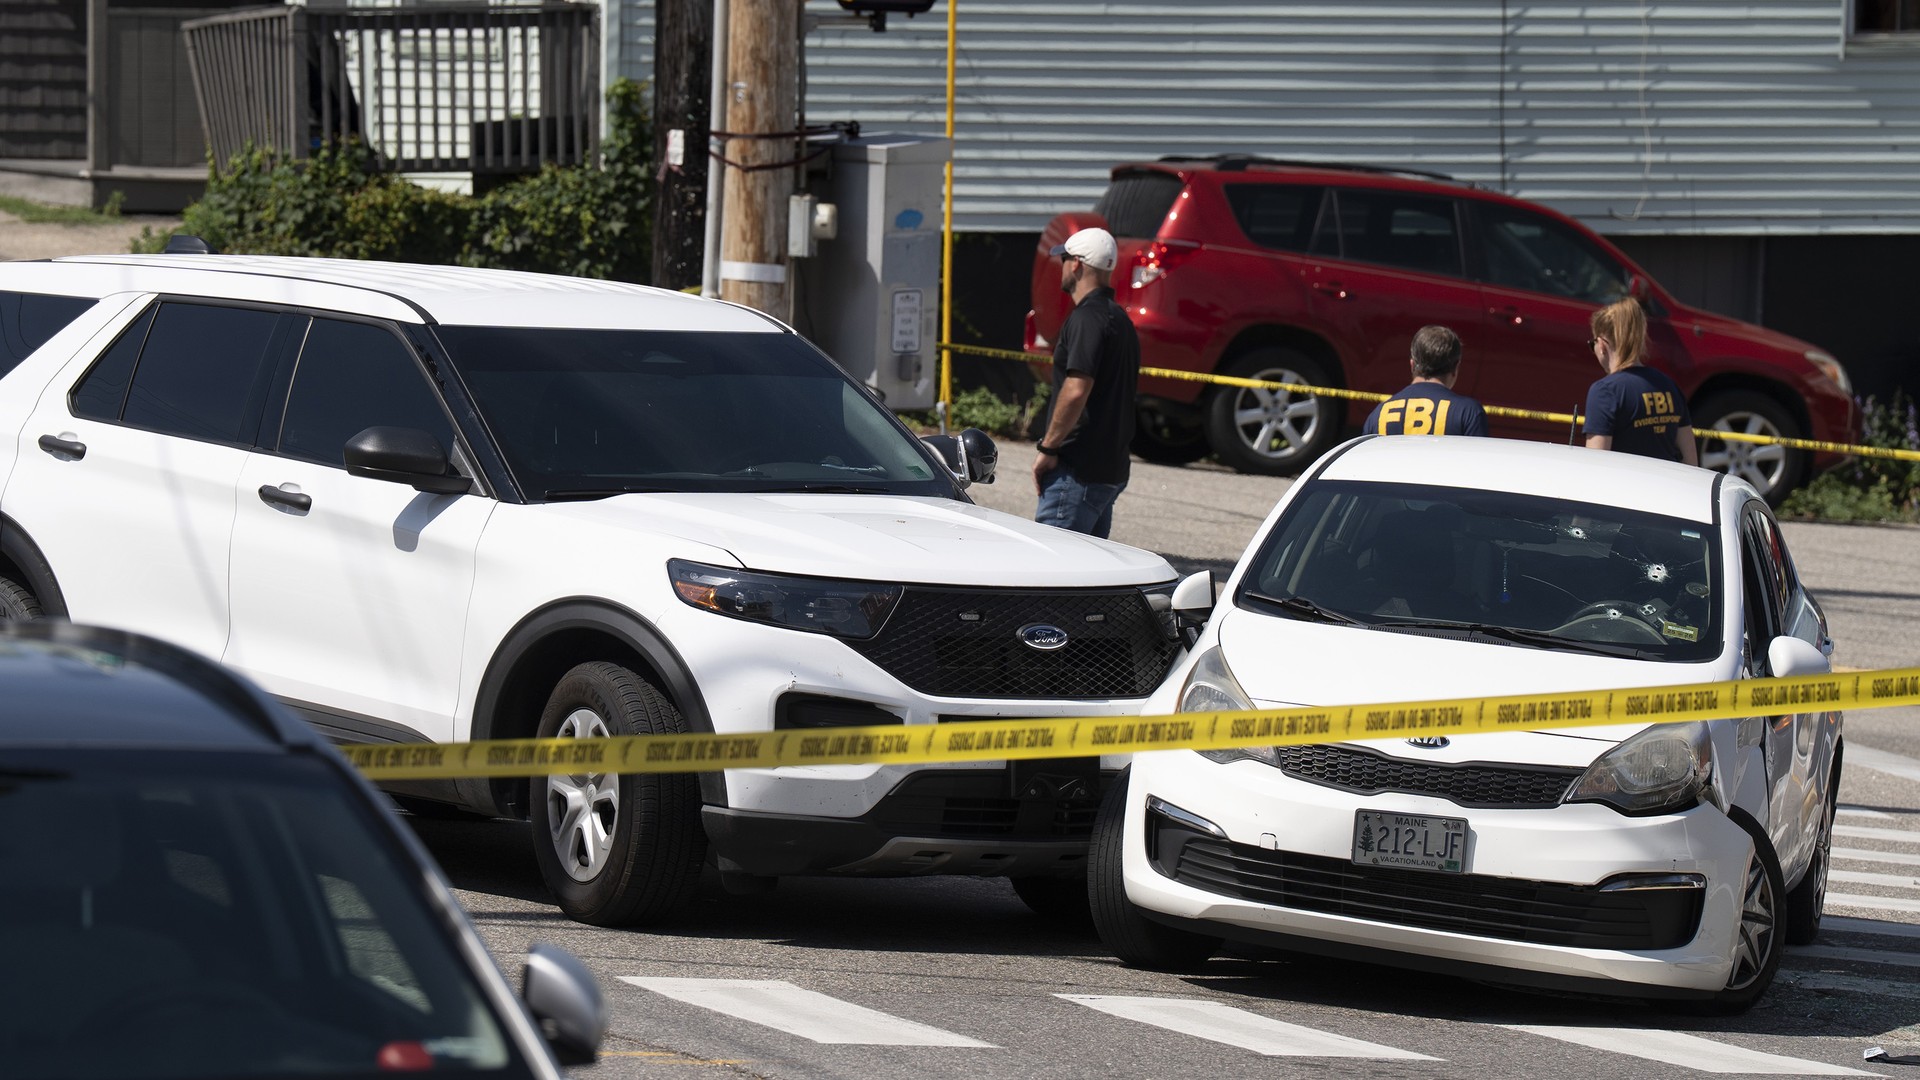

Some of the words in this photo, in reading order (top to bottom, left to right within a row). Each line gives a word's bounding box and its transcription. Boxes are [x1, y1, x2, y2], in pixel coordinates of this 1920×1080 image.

[1643, 392, 1674, 415] FBI
[1378, 398, 1450, 436] FBI
[1034, 630, 1058, 643] Ford
[1774, 685, 1788, 706] NOT
[1790, 684, 1800, 704] DO
[1801, 683, 1815, 704] LINE
[1816, 681, 1841, 703] POLICE
[1872, 678, 1893, 699] CROSS
[1895, 676, 1908, 697] NOT
[1910, 675, 1919, 696] DO
[1626, 695, 1649, 716] CROSS
[1650, 694, 1664, 714] NOT
[1666, 693, 1676, 713] DO
[1677, 692, 1693, 712] LINE
[1694, 690, 1718, 711] POLICE
[1751, 686, 1773, 707] CROSS
[1419, 708, 1436, 728] LINE
[1436, 706, 1463, 727] POLICE
[1497, 703, 1521, 724] CROSS
[1522, 702, 1536, 722] NOT
[1538, 701, 1549, 722] DO
[1550, 700, 1566, 721] LINE
[1566, 698, 1592, 719] POLICE
[1230, 718, 1256, 739] CROSS
[1257, 717, 1272, 737] NOT
[1273, 716, 1285, 736] DO
[1285, 715, 1304, 735] LINE
[1303, 714, 1331, 734] POLICE
[1366, 711, 1390, 731] CROSS
[1391, 710, 1406, 730] NOT
[1407, 709, 1419, 729] DO
[948, 731, 976, 751] CROSS
[976, 731, 993, 750] NOT
[994, 730, 1007, 749] DO
[1007, 729, 1026, 748] LINE
[1026, 728, 1056, 748] POLICE
[1092, 725, 1118, 745] CROSS
[1119, 724, 1135, 744] NOT
[1136, 723, 1149, 743] DO
[1148, 722, 1167, 742] LINE
[1167, 721, 1195, 741] POLICE
[799, 736, 828, 757] CROSS
[828, 736, 846, 756] NOT
[847, 735, 860, 756] DO
[860, 734, 880, 755] LINE
[880, 733, 911, 754] POLICE
[1395, 817, 1428, 828] MAINE
[1380, 856, 1436, 867] VACATIONLAND
